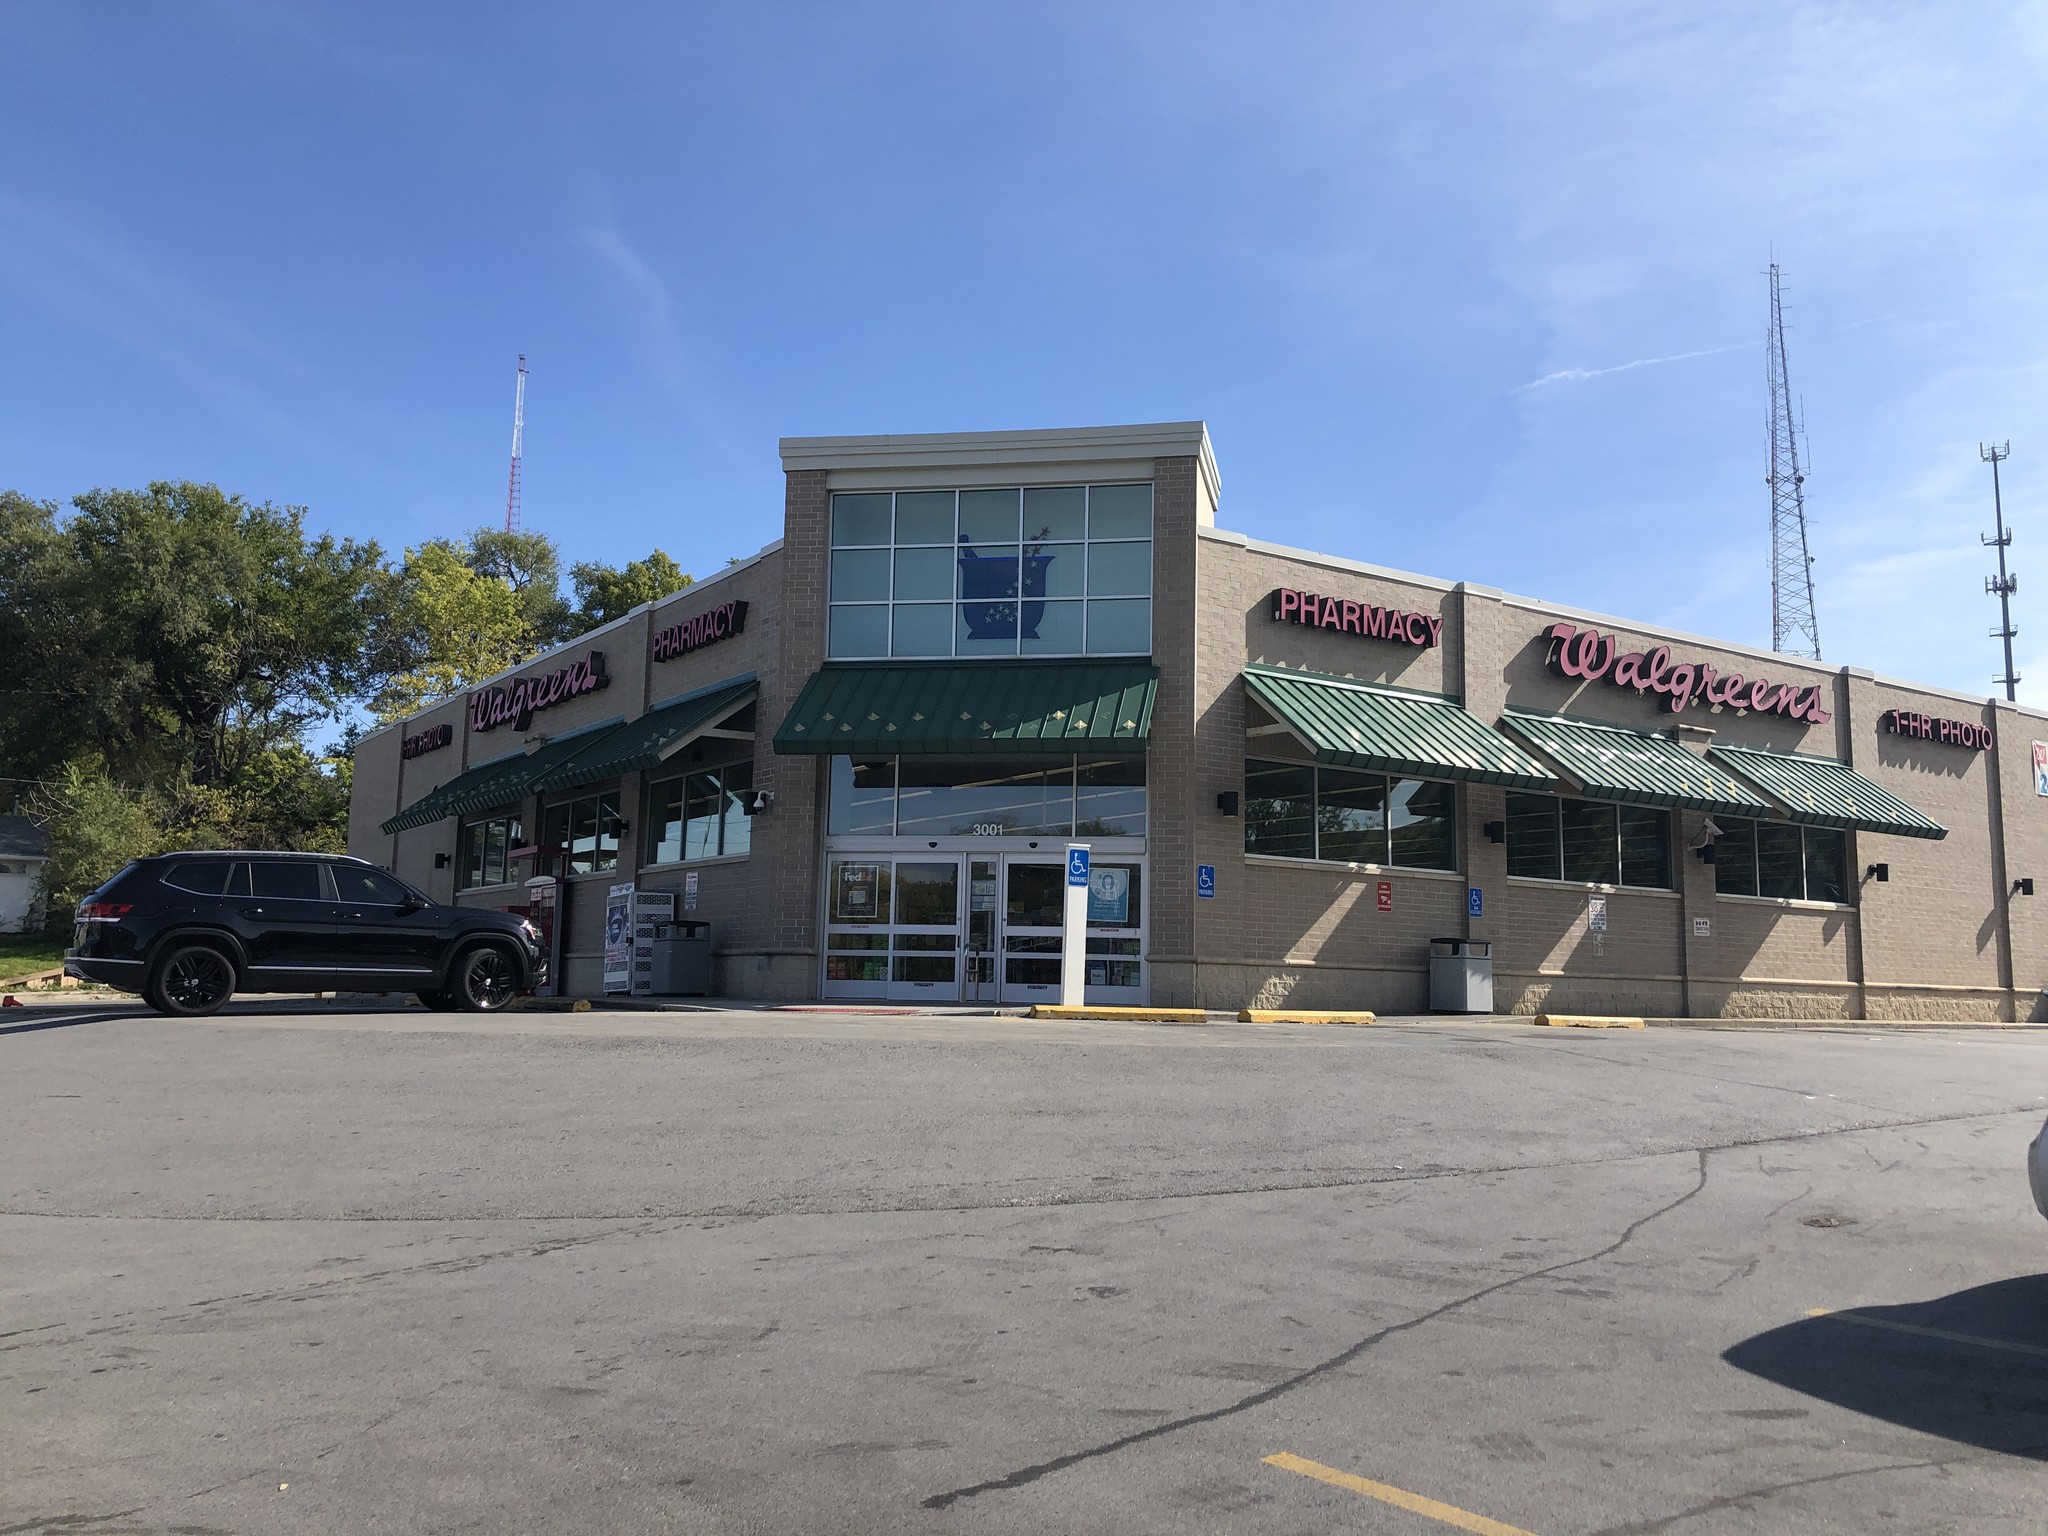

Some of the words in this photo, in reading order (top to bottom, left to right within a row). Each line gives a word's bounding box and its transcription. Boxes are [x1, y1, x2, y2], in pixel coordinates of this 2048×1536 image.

[652, 600, 737, 662] PHARMACY
[1280, 588, 1444, 647] PHARMACY
[470, 650, 597, 732] Walgreens
[1551, 623, 1831, 724] Walgreens
[418, 724, 444, 752] PHOTO
[1892, 709, 1932, 739] 1-HR
[1939, 718, 1993, 751] PHOTO
[973, 823, 1003, 836] 3001
[844, 871, 873, 882] FedEx
[1069, 875, 1087, 883] PARKING
